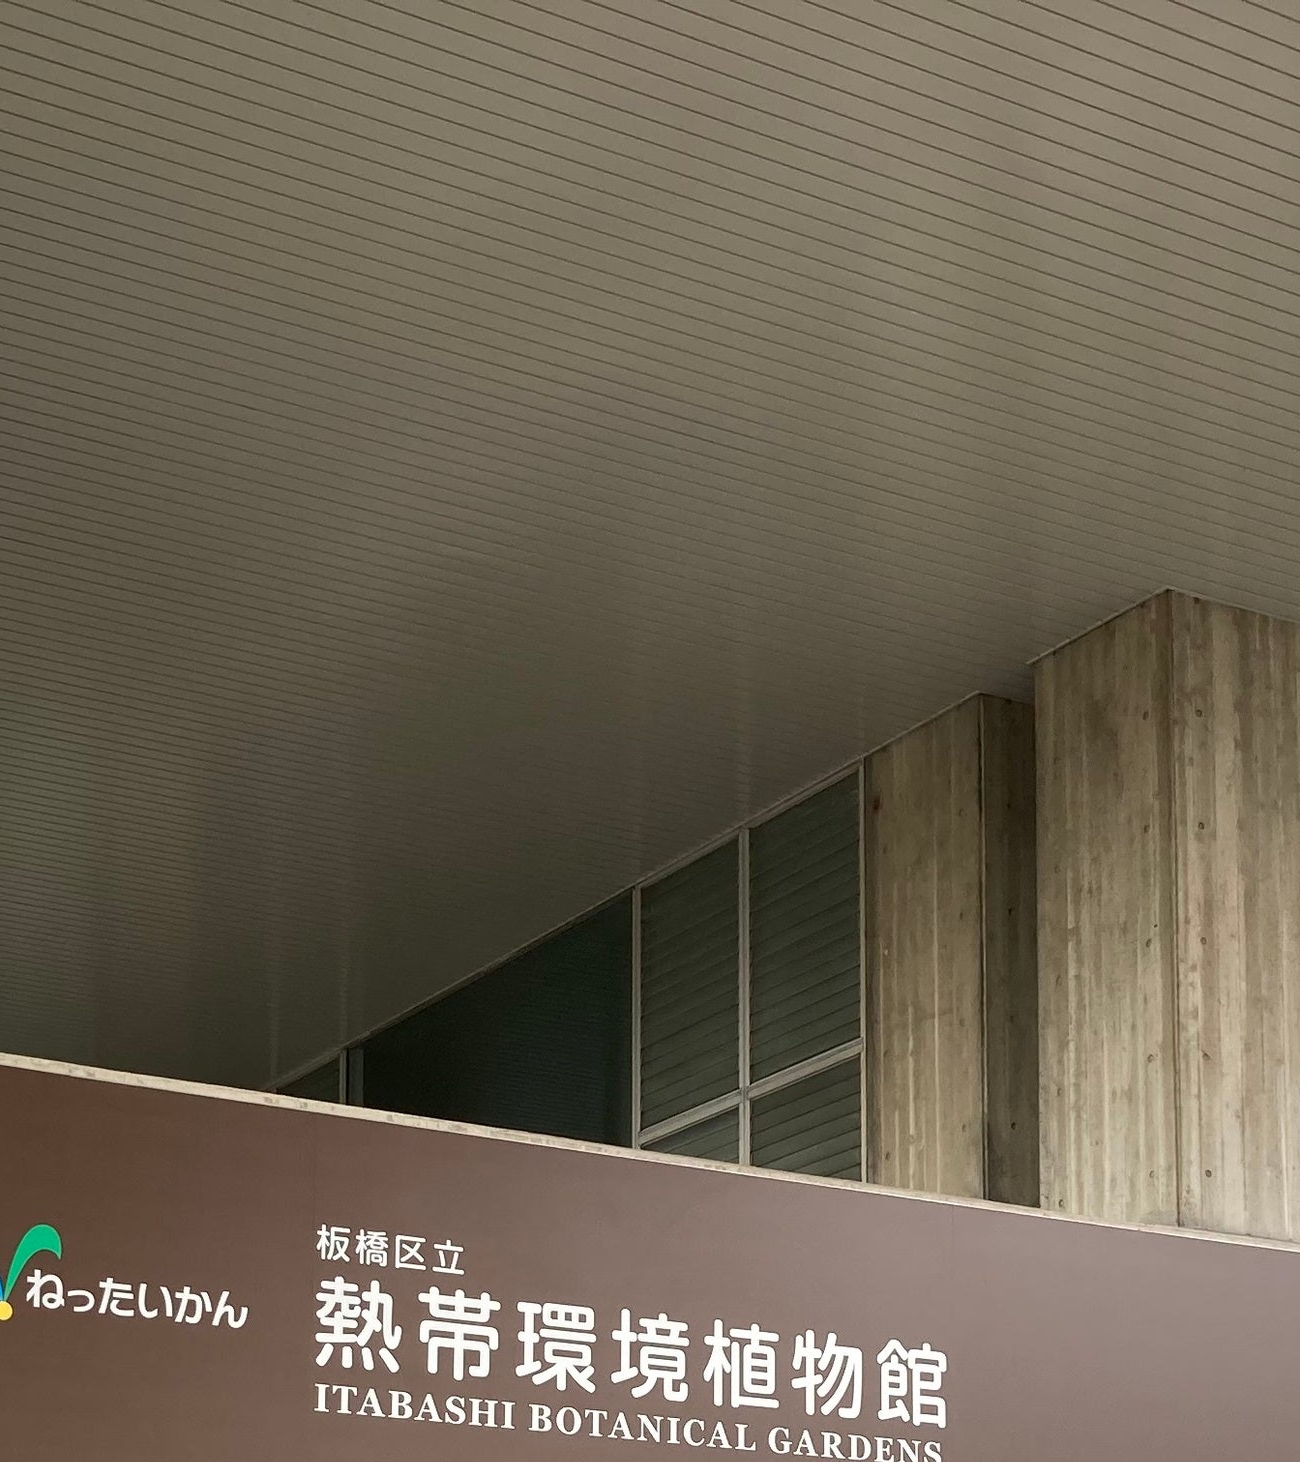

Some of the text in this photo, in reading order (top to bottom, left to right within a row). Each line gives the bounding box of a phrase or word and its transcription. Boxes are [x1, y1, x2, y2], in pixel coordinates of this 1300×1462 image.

[316, 1224, 465, 1276] 板橋区立
[26, 1269, 249, 1330] ねったいかん
[315, 1276, 948, 1429] 熱帯環境植物館
[313, 1383, 516, 1430] ITABASHI
[528, 1402, 757, 1451] BOTANICAL
